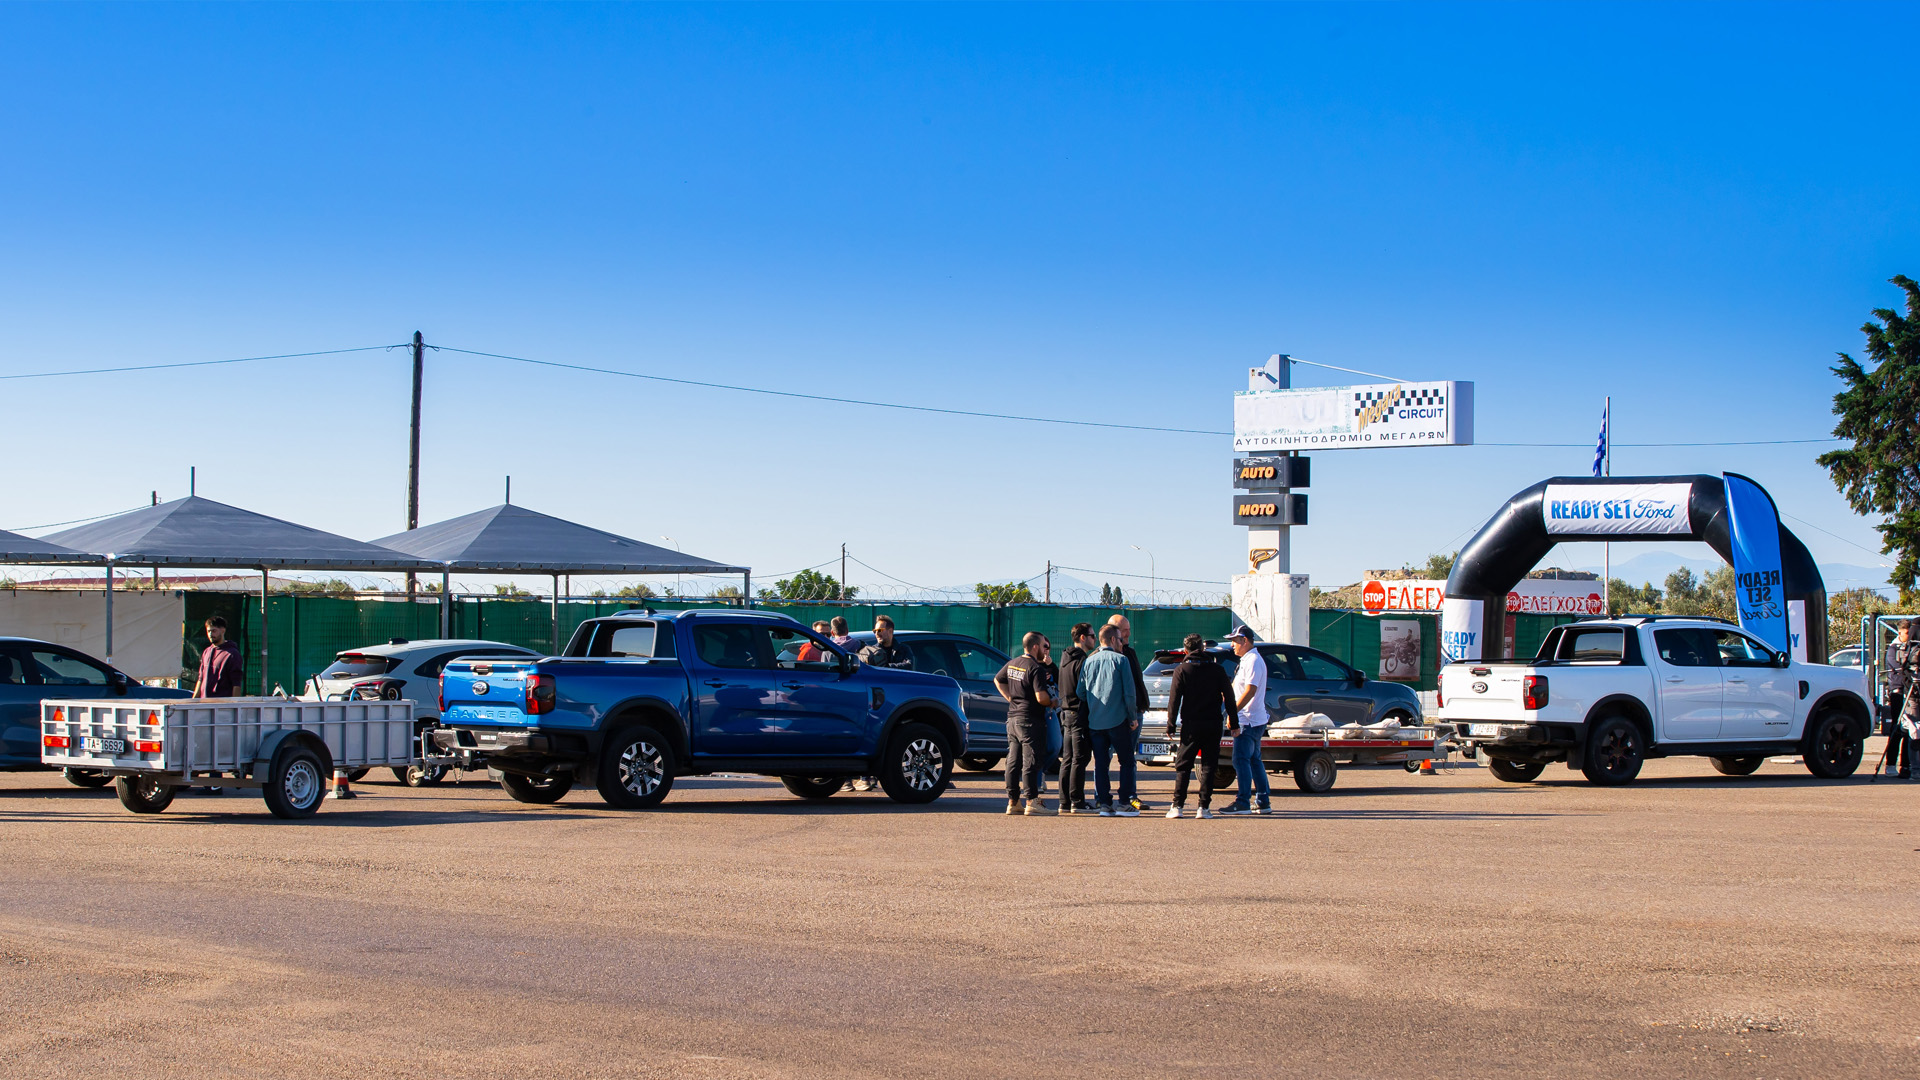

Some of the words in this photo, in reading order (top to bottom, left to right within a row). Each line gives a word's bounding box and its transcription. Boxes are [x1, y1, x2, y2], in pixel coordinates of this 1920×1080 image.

[1358, 384, 1401, 433] Megara
[1398, 408, 1444, 419] CIRCUIT
[1235, 433, 1373, 446] ΑΥΤΟΚΙΝΗΤΟΔΡΟΜΙΟ
[1379, 431, 1445, 441] ΜΕΓΑΡΩΝ
[1240, 466, 1275, 479] AUTO
[1238, 503, 1276, 516] MOTO
[1551, 499, 1601, 519] READY
[1603, 499, 1633, 519] SET
[1633, 498, 1677, 519] Ford
[1364, 592, 1384, 603] STOP
[1521, 595, 1585, 612] ΕΛΕΓΧΟΣ
[1444, 630, 1477, 646] READY
[1447, 645, 1467, 659] SET
[449, 709, 520, 720] RANGER
